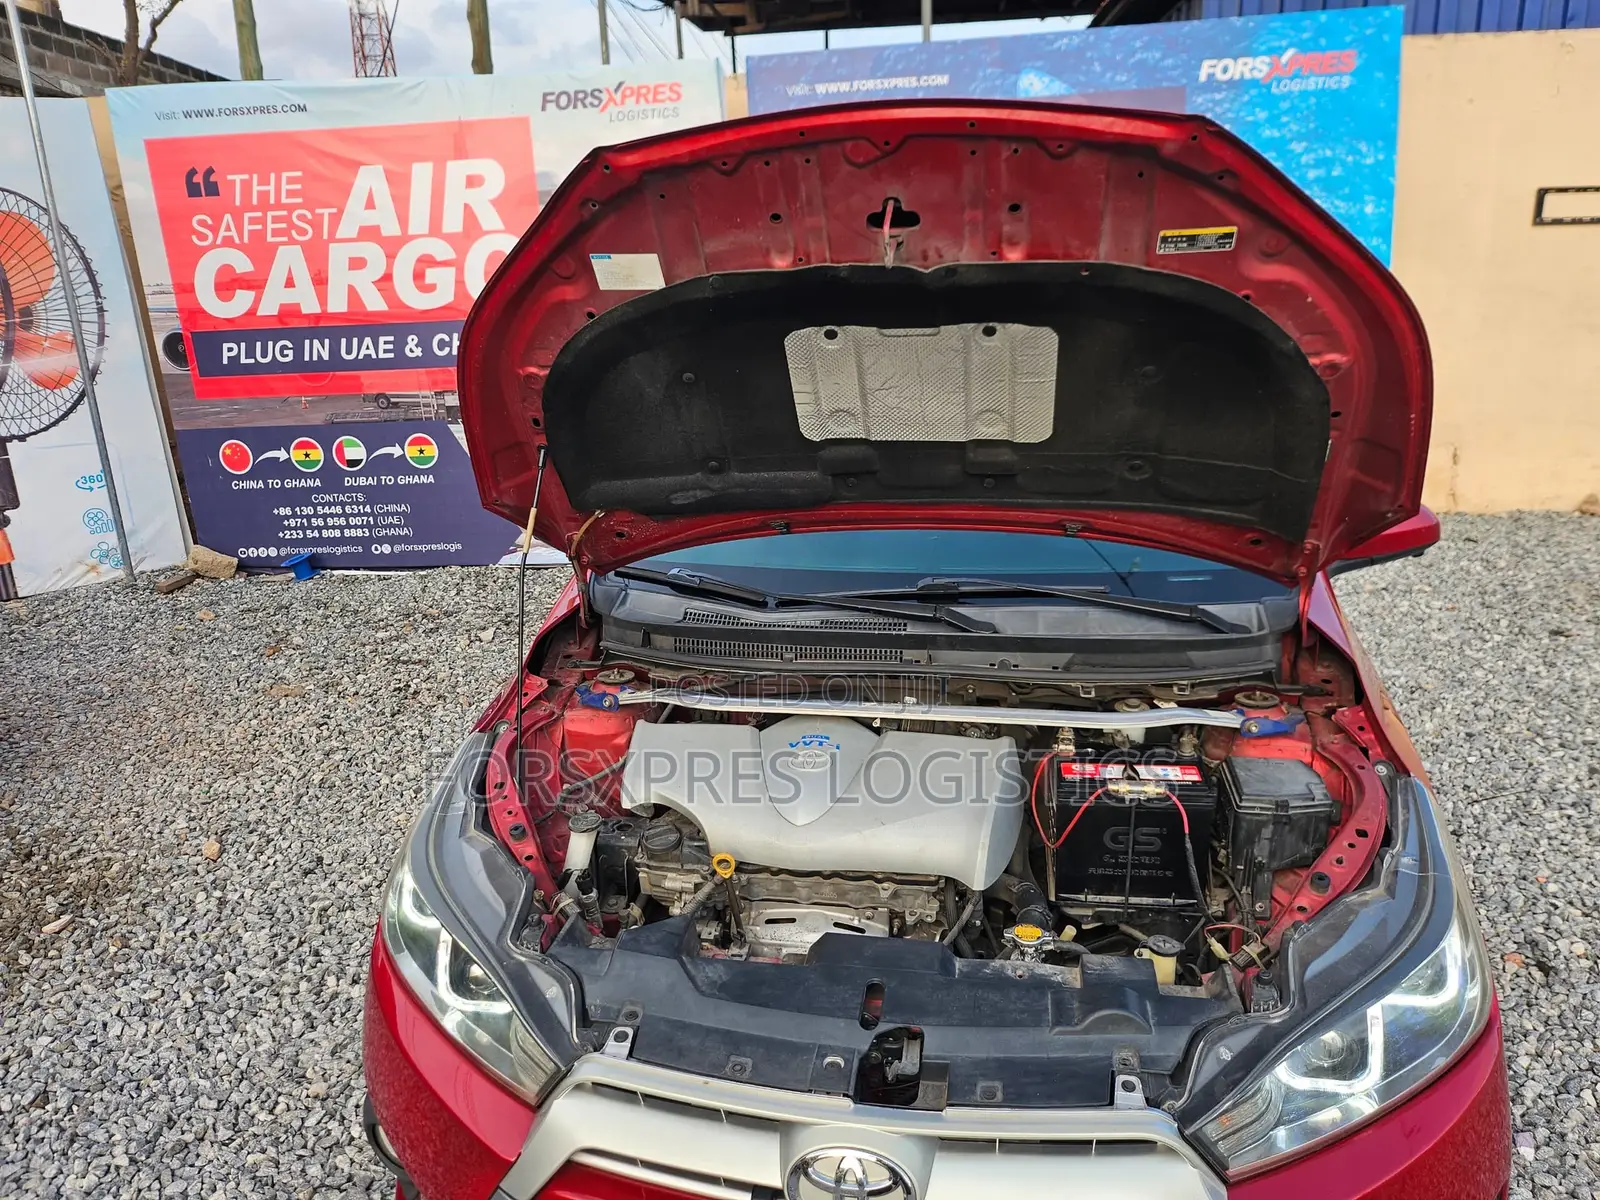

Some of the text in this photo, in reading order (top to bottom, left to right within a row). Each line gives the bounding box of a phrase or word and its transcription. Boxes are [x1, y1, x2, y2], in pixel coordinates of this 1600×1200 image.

[1198, 47, 1358, 83] FORSXPRES
[1271, 75, 1351, 94] LOGISTICS
[541, 81, 684, 112] FORSXPRES
[155, 103, 308, 121] Visit: WWW.FORSXPRES.COM
[609, 107, 680, 123] LOGISTICS
[226, 171, 303, 207] THE
[191, 158, 506, 247] SAFEST AIR
[222, 339, 294, 365] PLUG
[303, 338, 330, 362] IN
[340, 335, 395, 361] UAE
[404, 334, 423, 358] &
[231, 477, 322, 490] CHINA TO GHANA
[344, 474, 435, 487] DUBAI TO GHANA
[311, 493, 367, 503] CONTACTS:
[273, 503, 411, 516] +86 130 5446 6314 (CHINA)
[283, 515, 404, 527] +971 56 956 0071 (UAE)
[278, 526, 413, 539] +233 54 808 8883 (GHANA)
[279, 545, 363, 556] @forsxpreslogistics
[393, 542, 462, 553] @forsxpreslogis
[1103, 826, 1162, 851] GS
